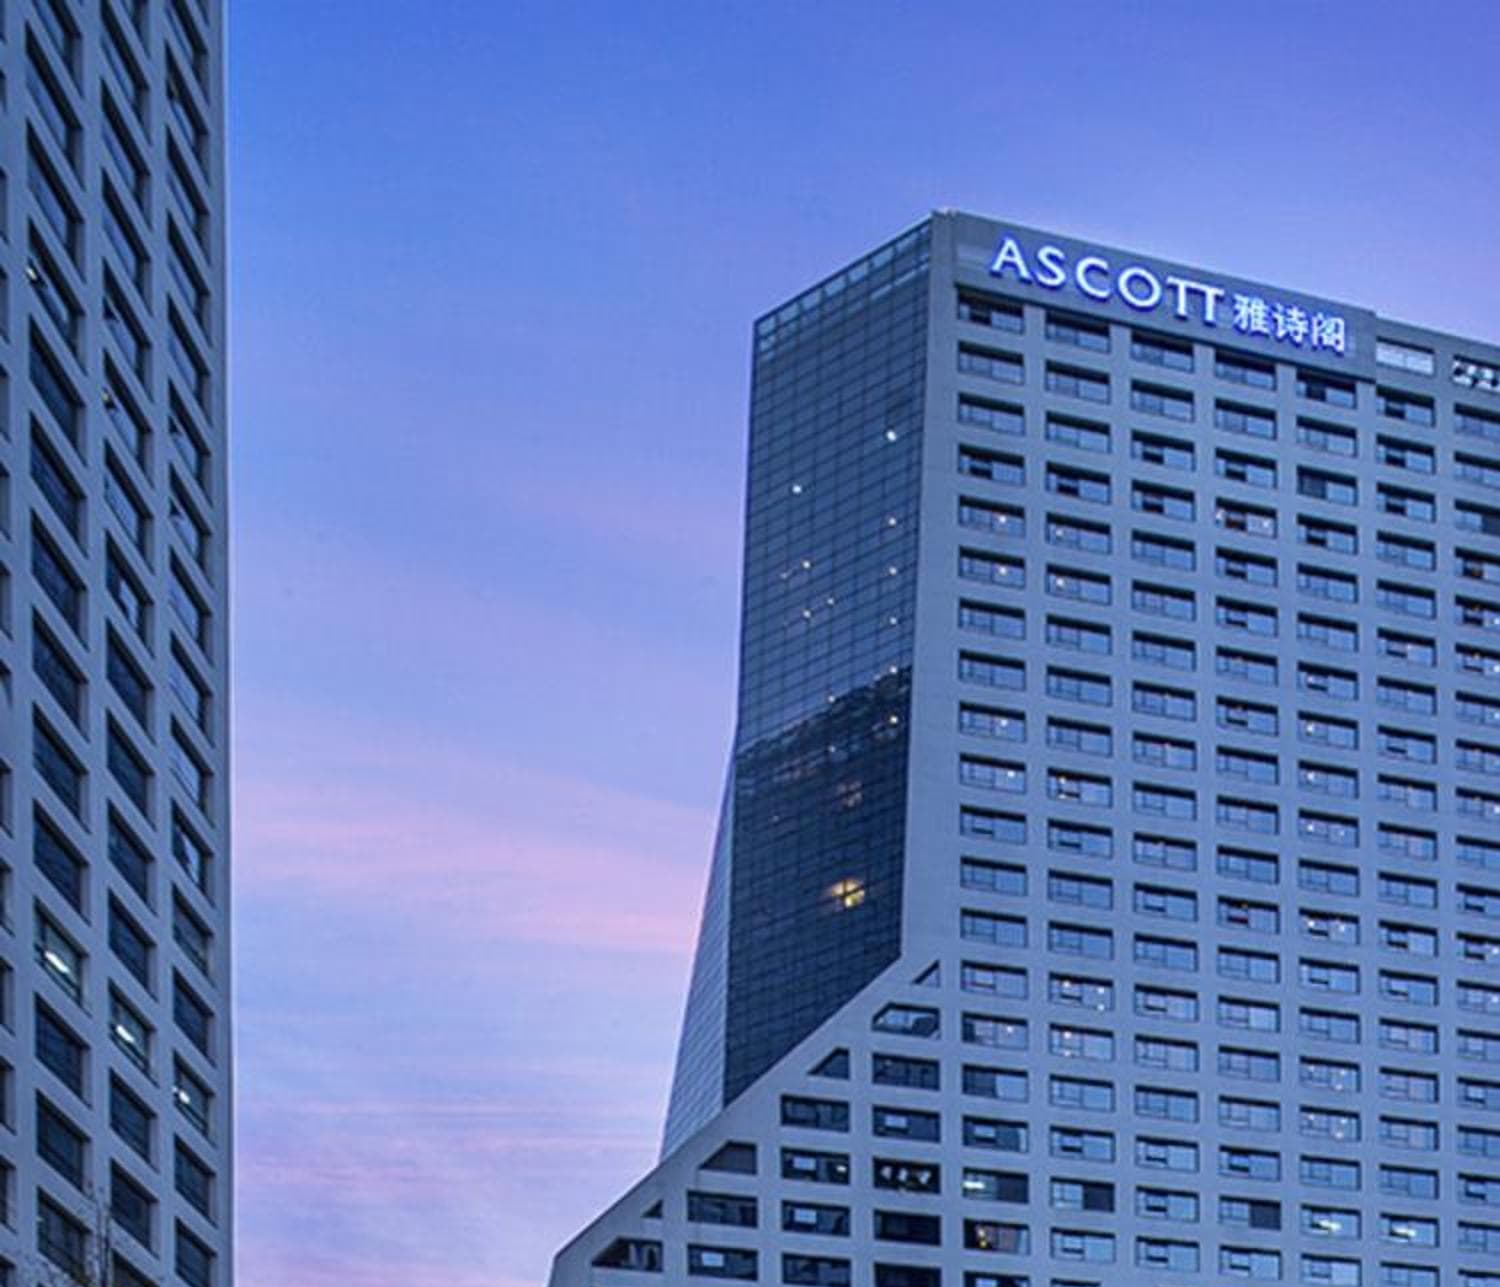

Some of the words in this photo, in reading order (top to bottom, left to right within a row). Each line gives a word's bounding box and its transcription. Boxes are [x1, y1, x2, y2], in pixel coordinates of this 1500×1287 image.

[991, 237, 1225, 323] ASCOTT
[1232, 292, 1346, 353] 雅诗阁
